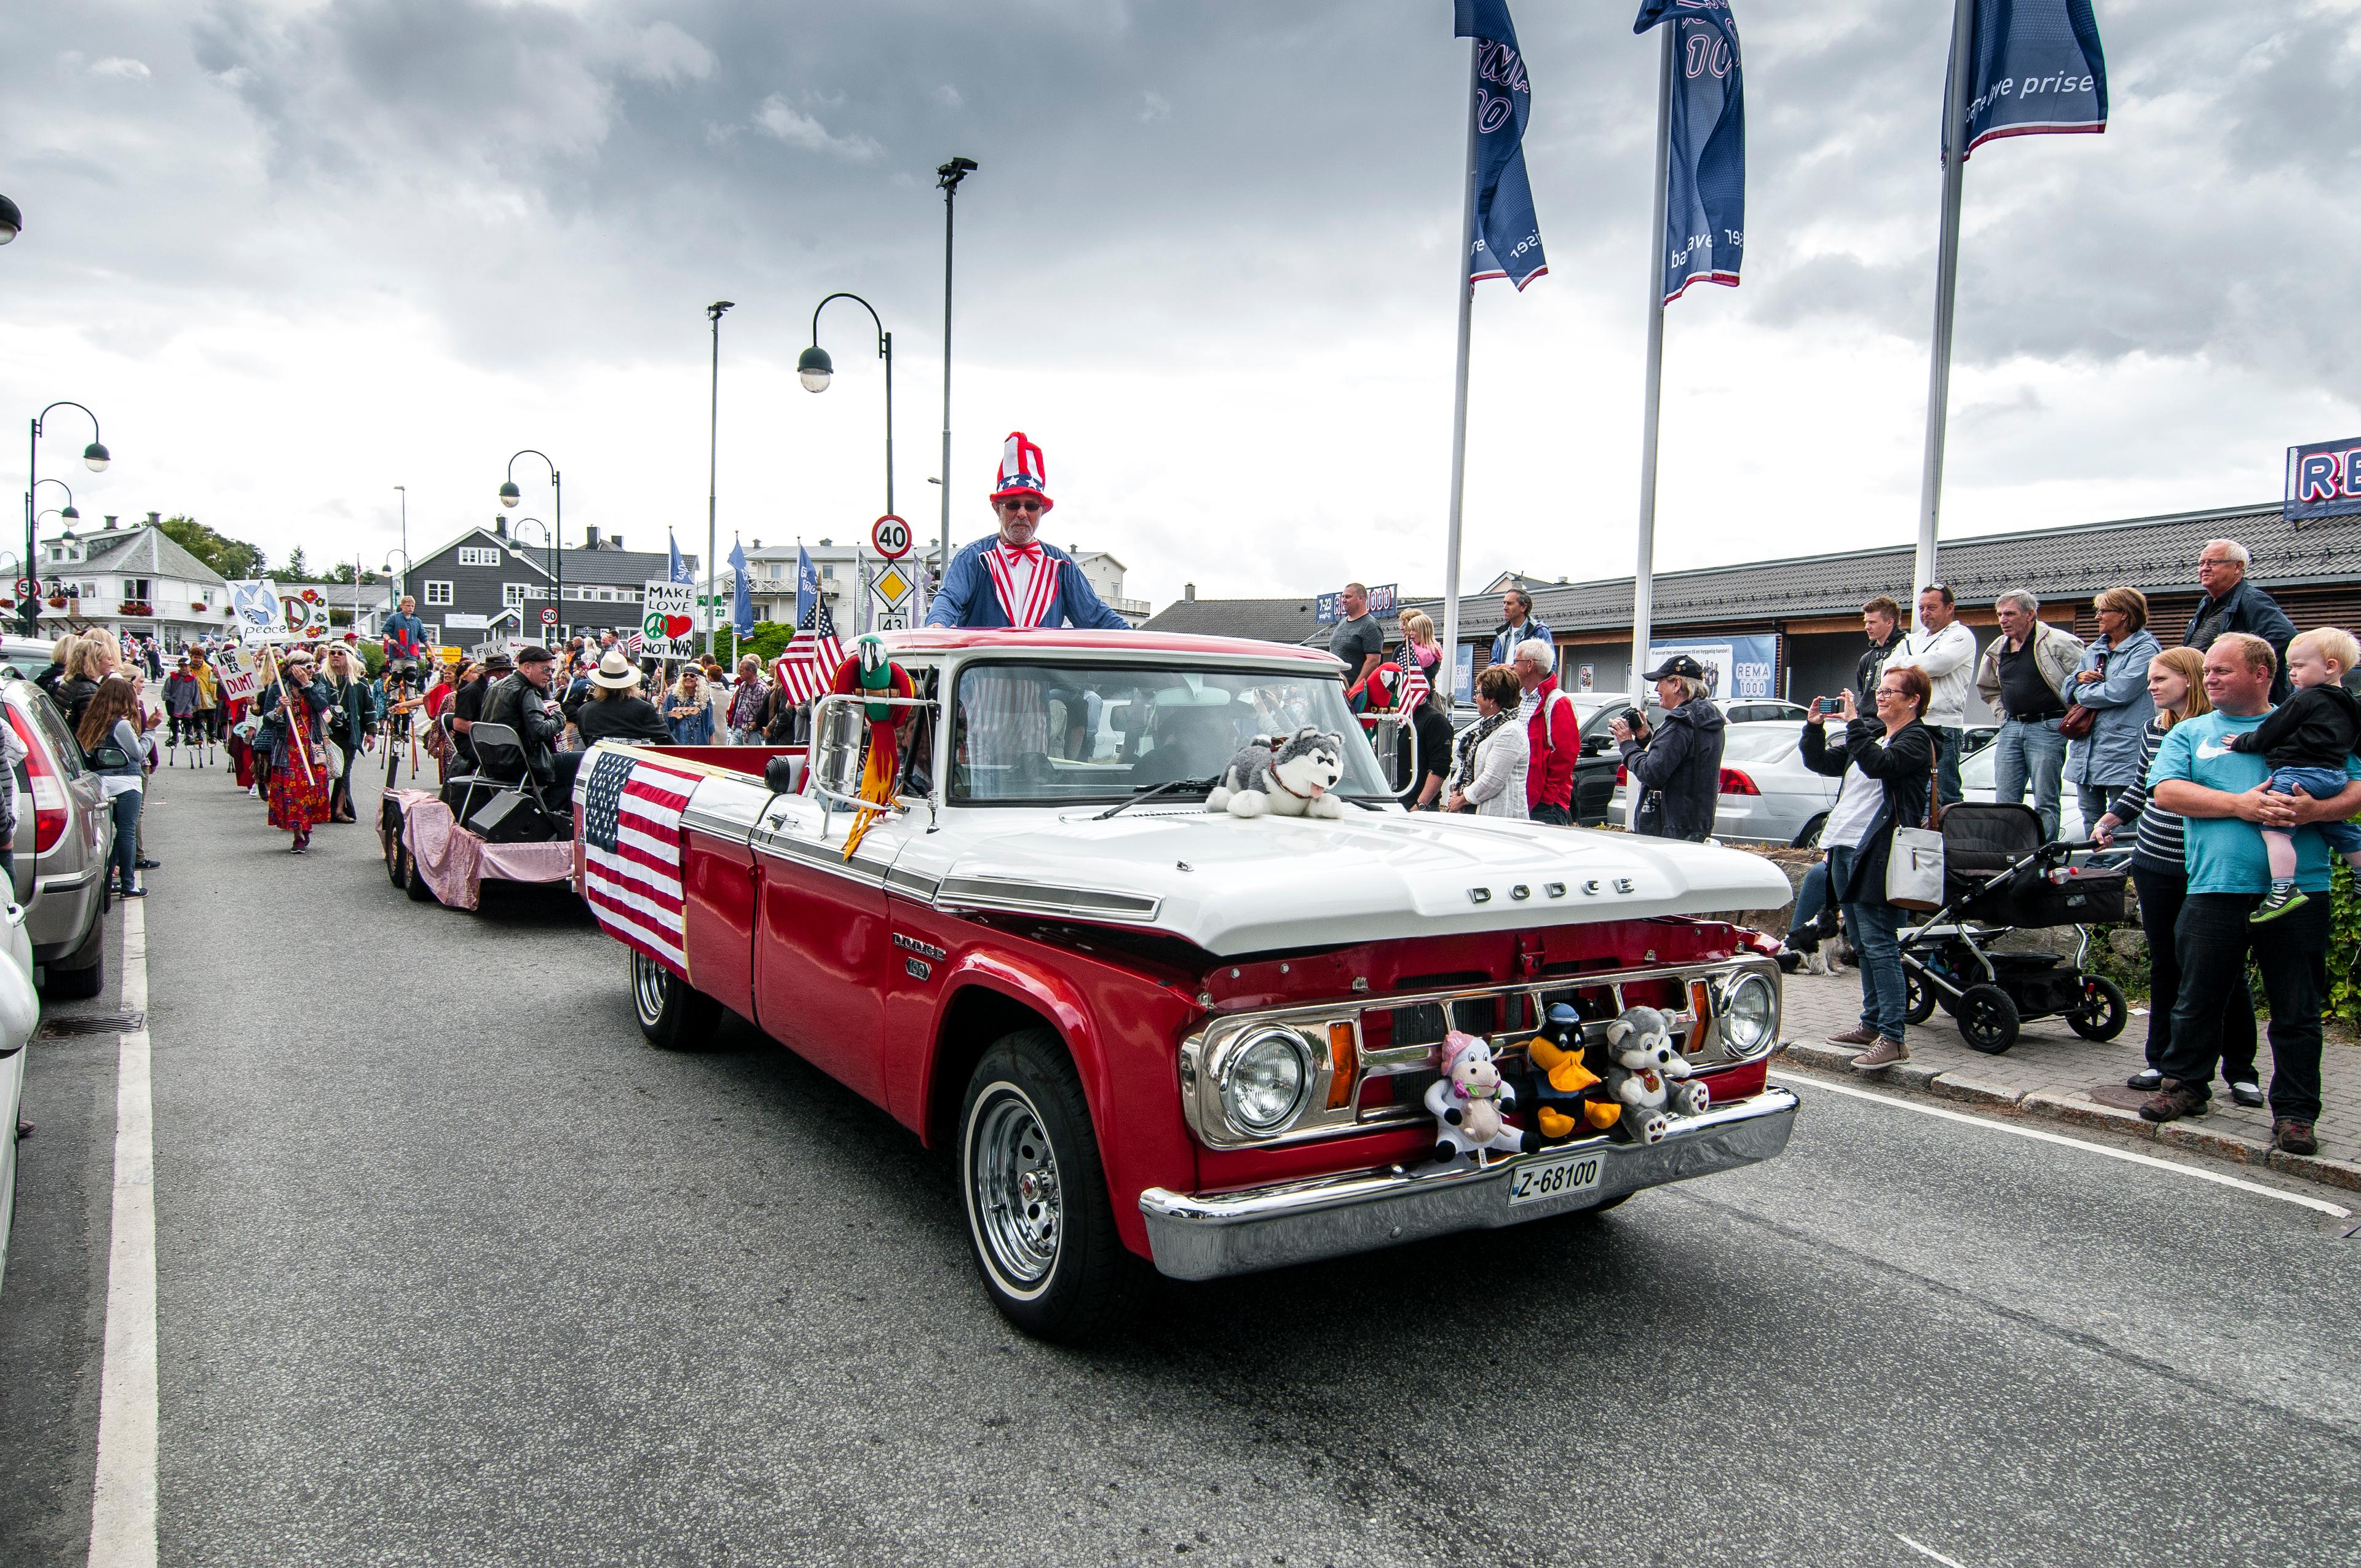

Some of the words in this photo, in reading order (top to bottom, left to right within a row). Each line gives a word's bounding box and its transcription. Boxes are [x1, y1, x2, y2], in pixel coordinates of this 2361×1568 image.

[879, 526, 906, 548] 40
[649, 587, 692, 600] MAKE
[649, 601, 690, 612] LOVE
[544, 612, 556, 620] 50
[244, 625, 287, 639] peace
[883, 619, 903, 630] 43
[641, 642, 668, 655] NOT
[670, 639, 692, 656] WAR
[217, 651, 236, 667] KRIG
[227, 663, 242, 674] ER
[1736, 665, 1770, 678] REMA
[226, 672, 255, 694] DUMT
[1741, 681, 1765, 694] 1000
[1467, 878, 1635, 904] DODGE
[893, 932, 946, 962] DODGE
[909, 960, 925, 976] 100
[1517, 1160, 1597, 1198] Z-68100
